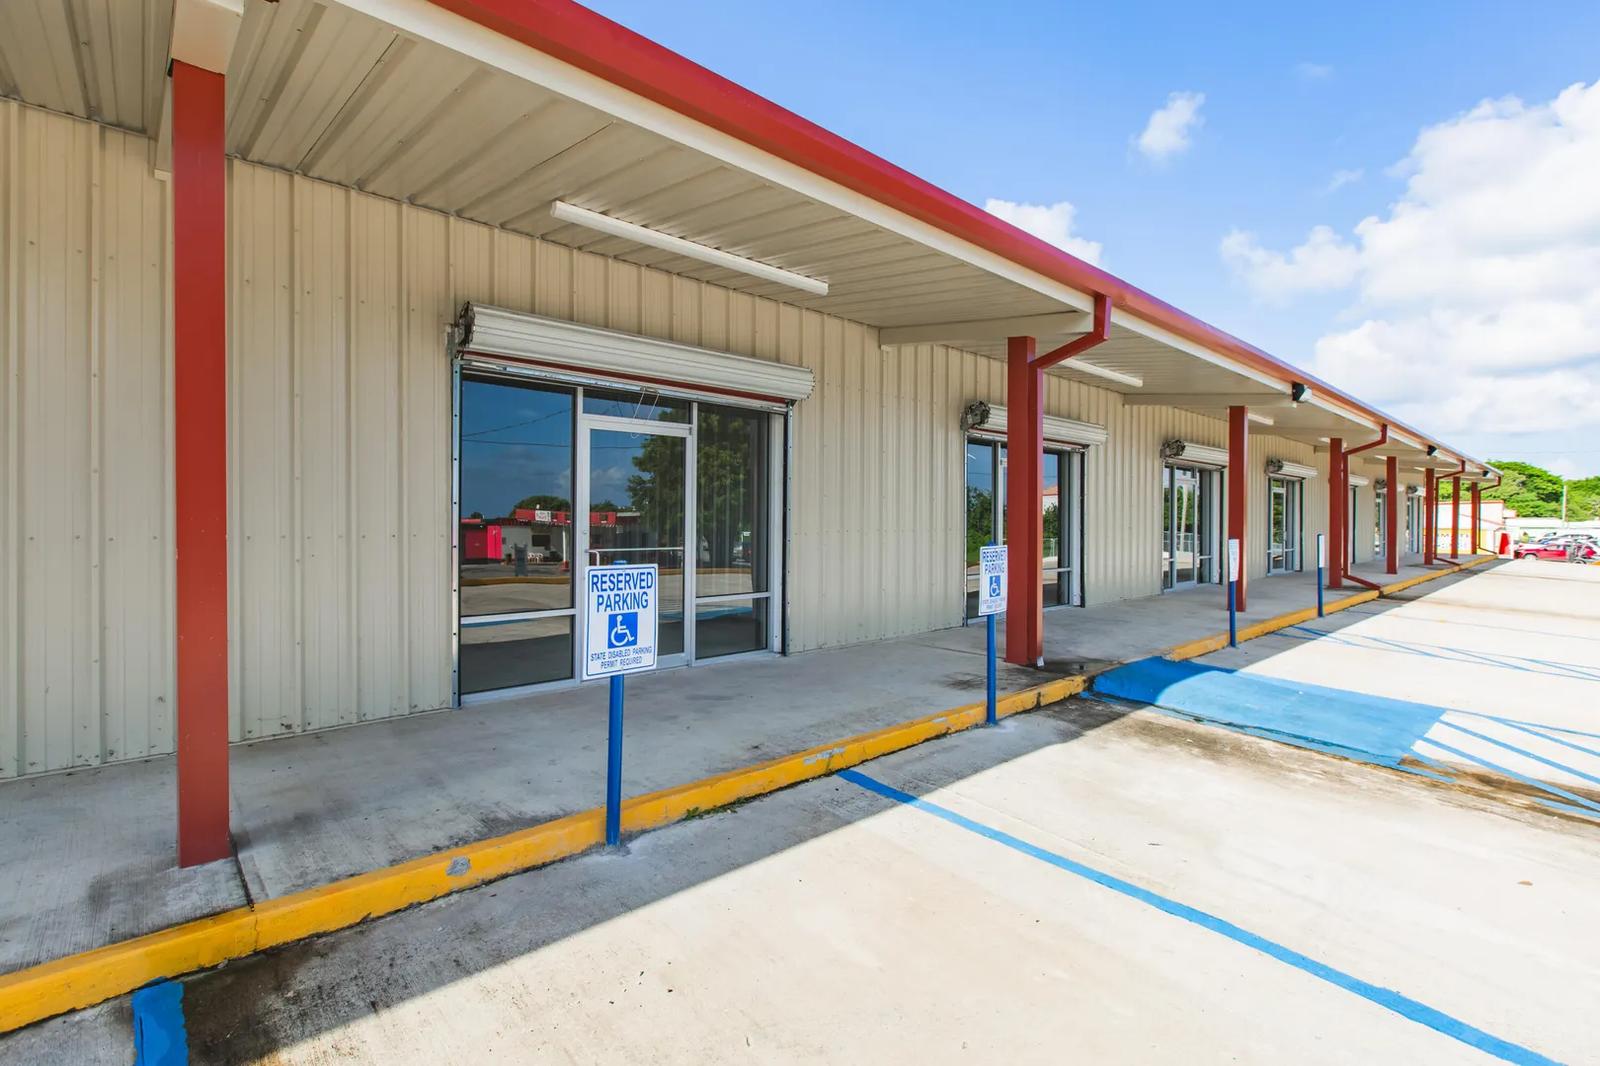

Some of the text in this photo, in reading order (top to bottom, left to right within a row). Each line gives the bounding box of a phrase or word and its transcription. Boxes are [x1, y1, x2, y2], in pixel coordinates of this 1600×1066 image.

[591, 572, 653, 592] RESERVED
[597, 591, 648, 612] PARKING
[591, 646, 652, 661] STATE DISABLED PARKING
[601, 655, 642, 669] PERMIT REQUIRED
